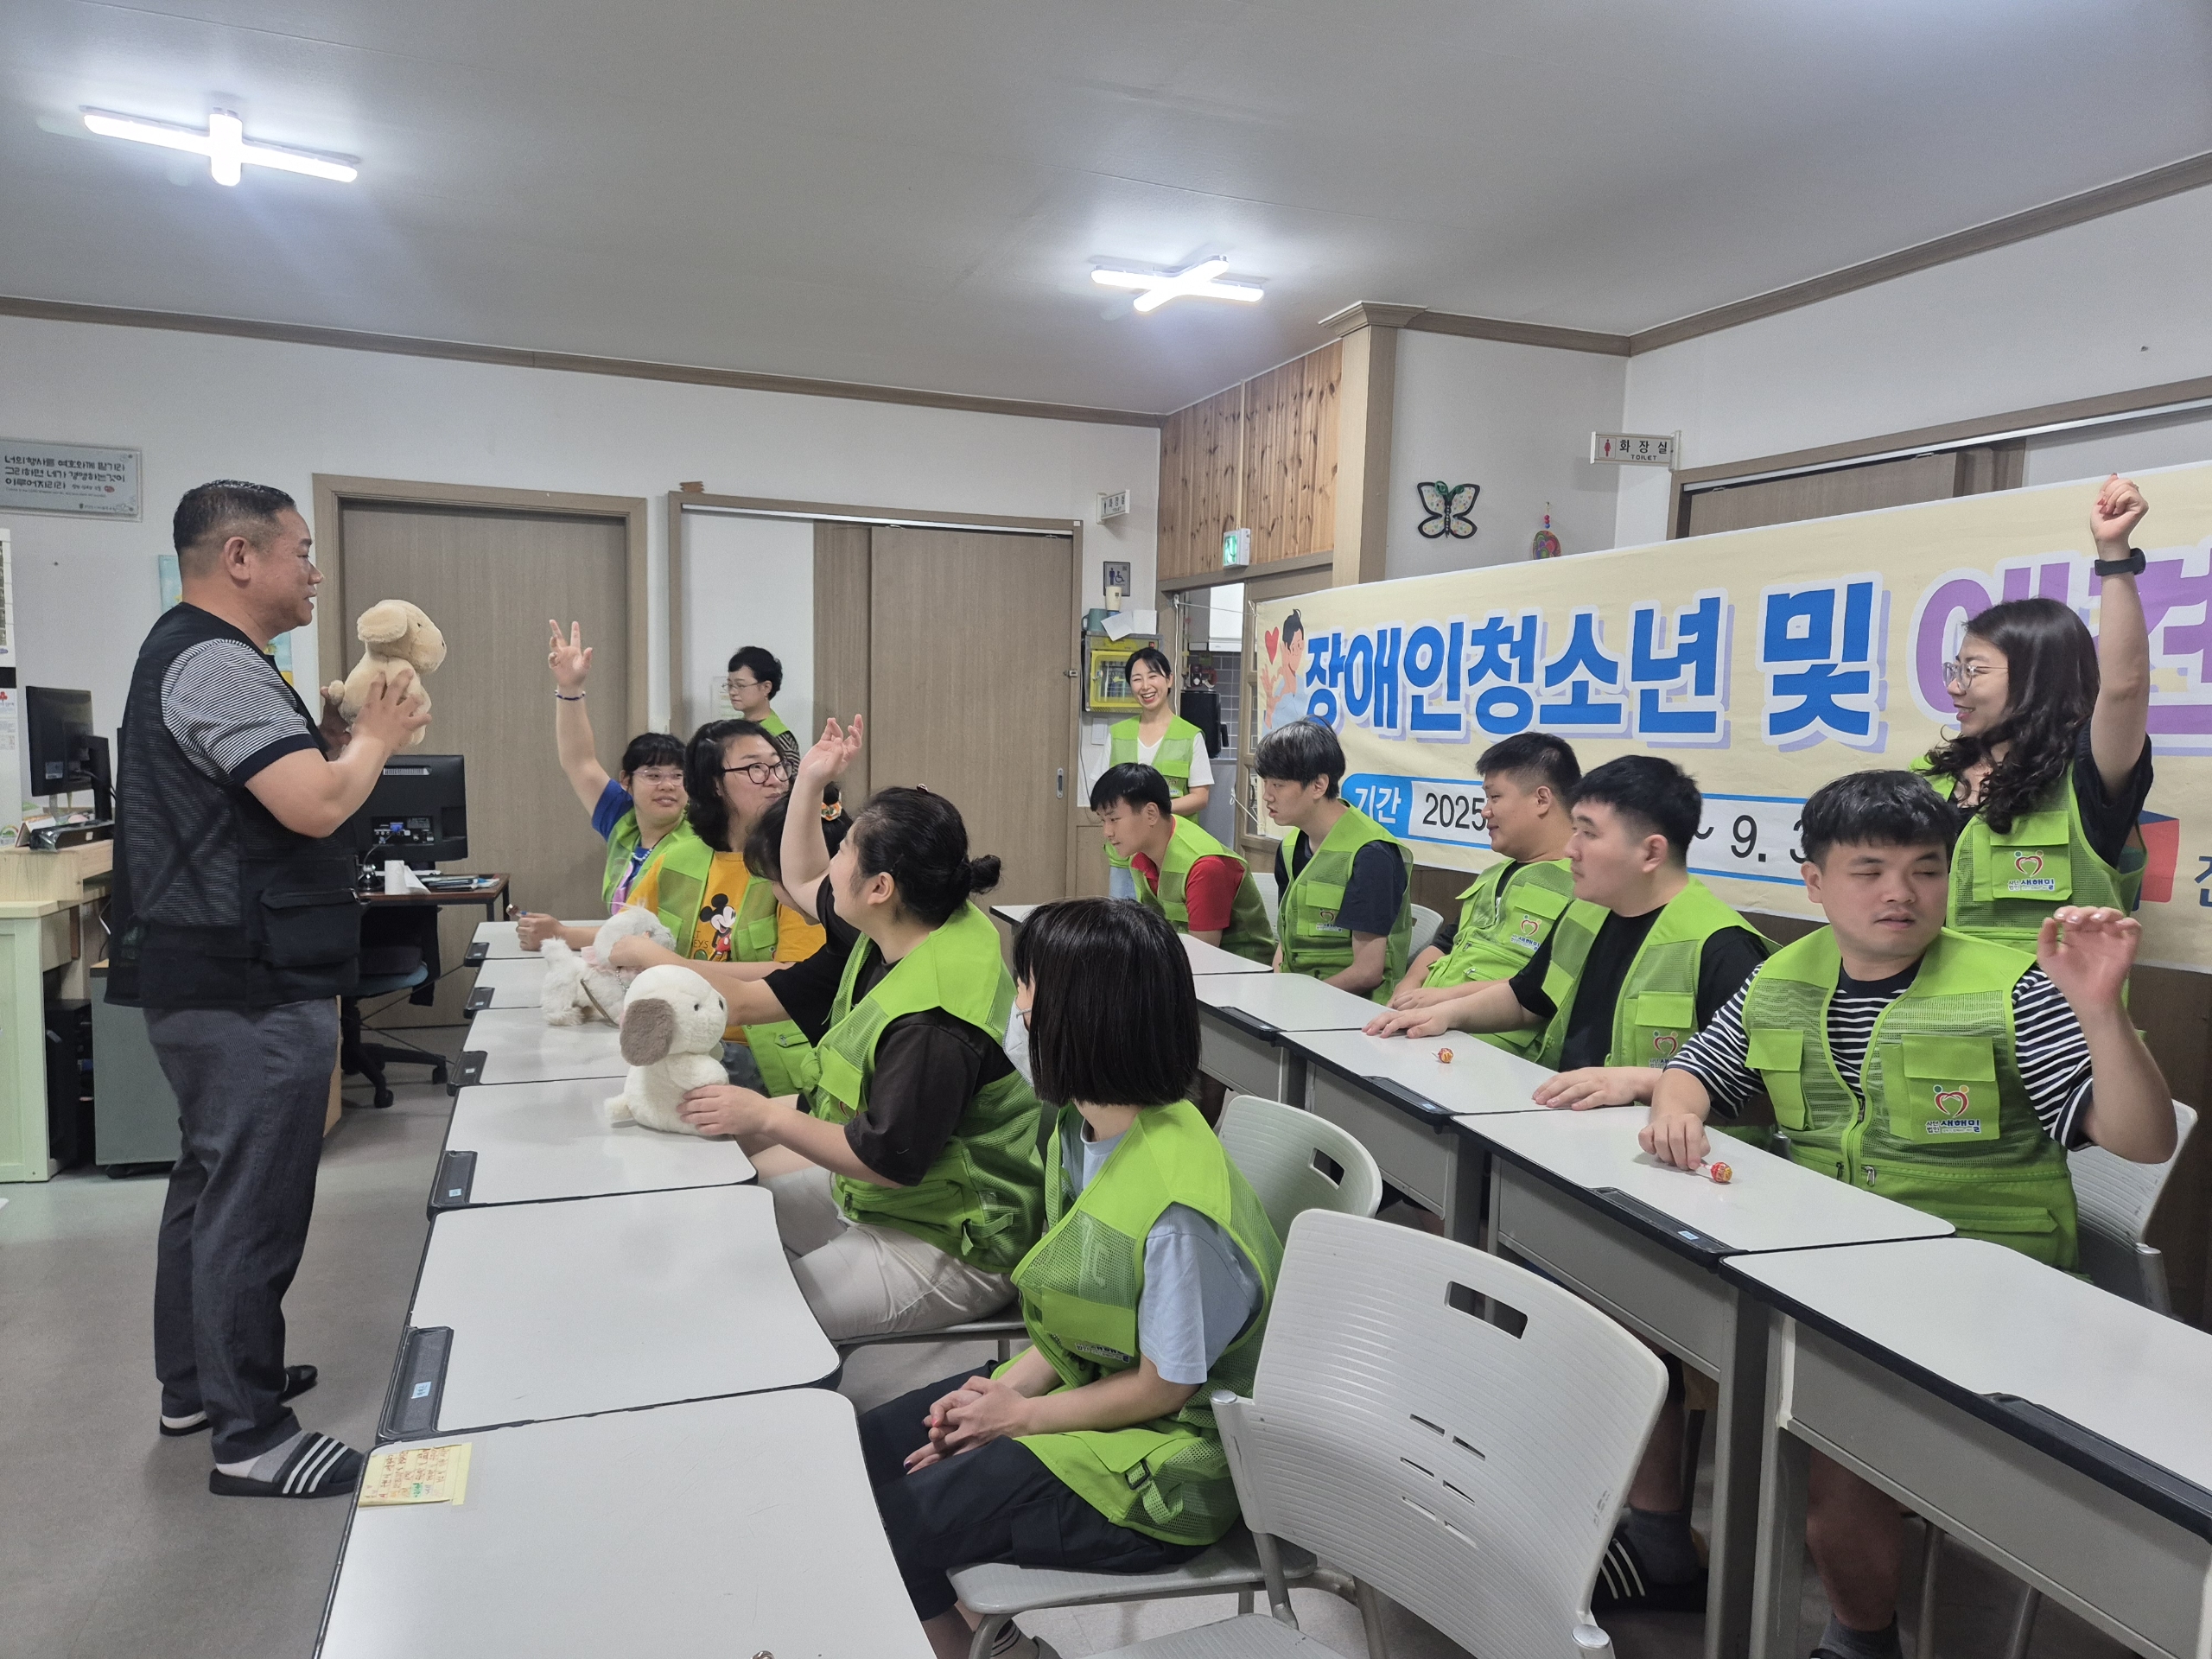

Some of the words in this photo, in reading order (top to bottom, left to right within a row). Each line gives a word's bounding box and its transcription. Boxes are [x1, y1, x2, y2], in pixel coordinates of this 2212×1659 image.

[1619, 439, 1668, 454] 화장실
[58, 459, 95, 469] 여호와께
[98, 462, 125, 472] 맡기라
[4, 467, 44, 477] 그리하면
[47, 469, 67, 479] 네가
[5, 478, 67, 490] 이루어지리라
[1305, 594, 1723, 736] 장애인청소년
[1763, 582, 1873, 736] 및
[1355, 785, 1402, 823] 기간
[1731, 815, 1766, 862] 9.
[2021, 879, 2055, 890] 새해밀
[1941, 1120, 1980, 1133] 새해밀
